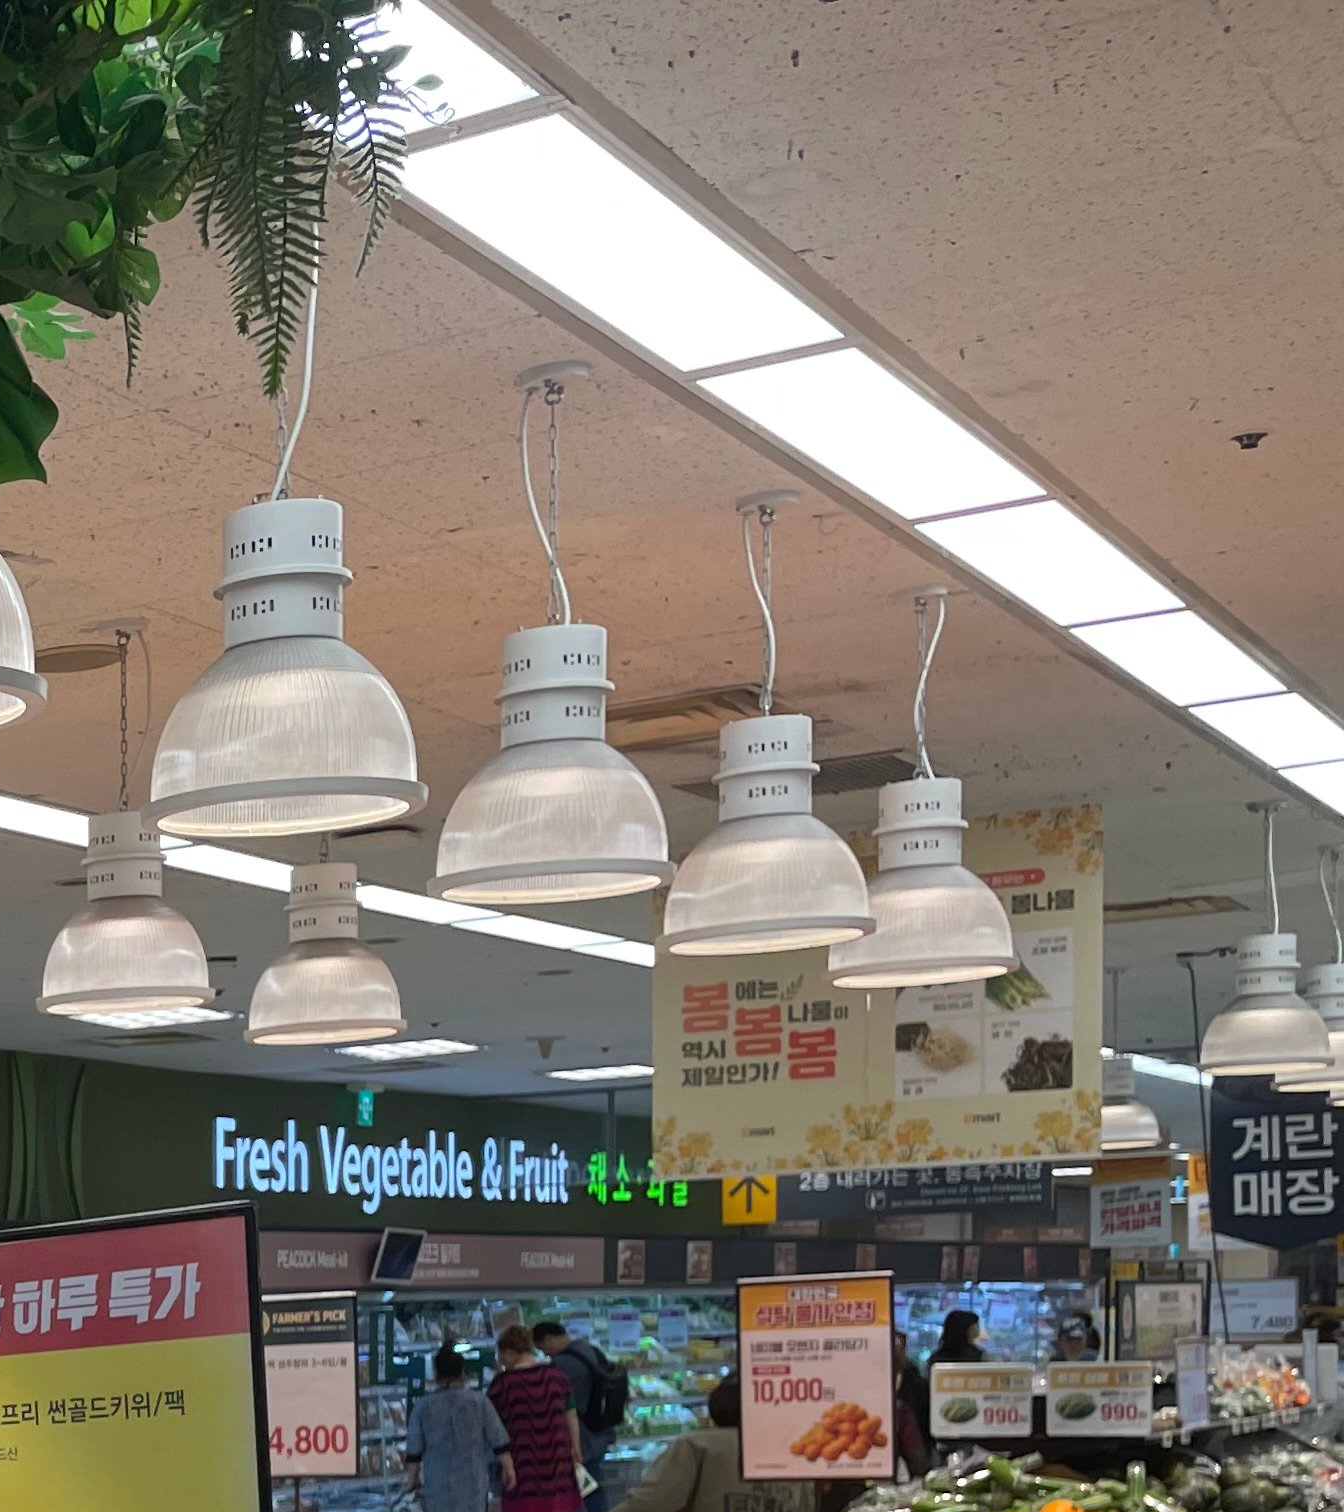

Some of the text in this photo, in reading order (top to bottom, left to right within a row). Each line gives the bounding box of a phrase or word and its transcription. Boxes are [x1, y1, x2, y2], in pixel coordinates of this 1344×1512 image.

[682, 981, 730, 1033] 봄
[733, 1004, 783, 1057] 봄
[682, 1027, 837, 1080] 역시 봄
[1232, 1112, 1338, 1161] 계란
[214, 1117, 569, 1215] Fresh Vegetable & Fruit
[1233, 1167, 1340, 1216] 매장
[277, 1249, 316, 1269] PEACOCK
[520, 1252, 551, 1268] PEACOCK
[12, 1273, 99, 1335] 하루
[108, 1262, 201, 1324] 특가
[273, 1310, 347, 1325] FARMER'S PICK
[47, 1389, 185, 1425] 썬골드키위/팩
